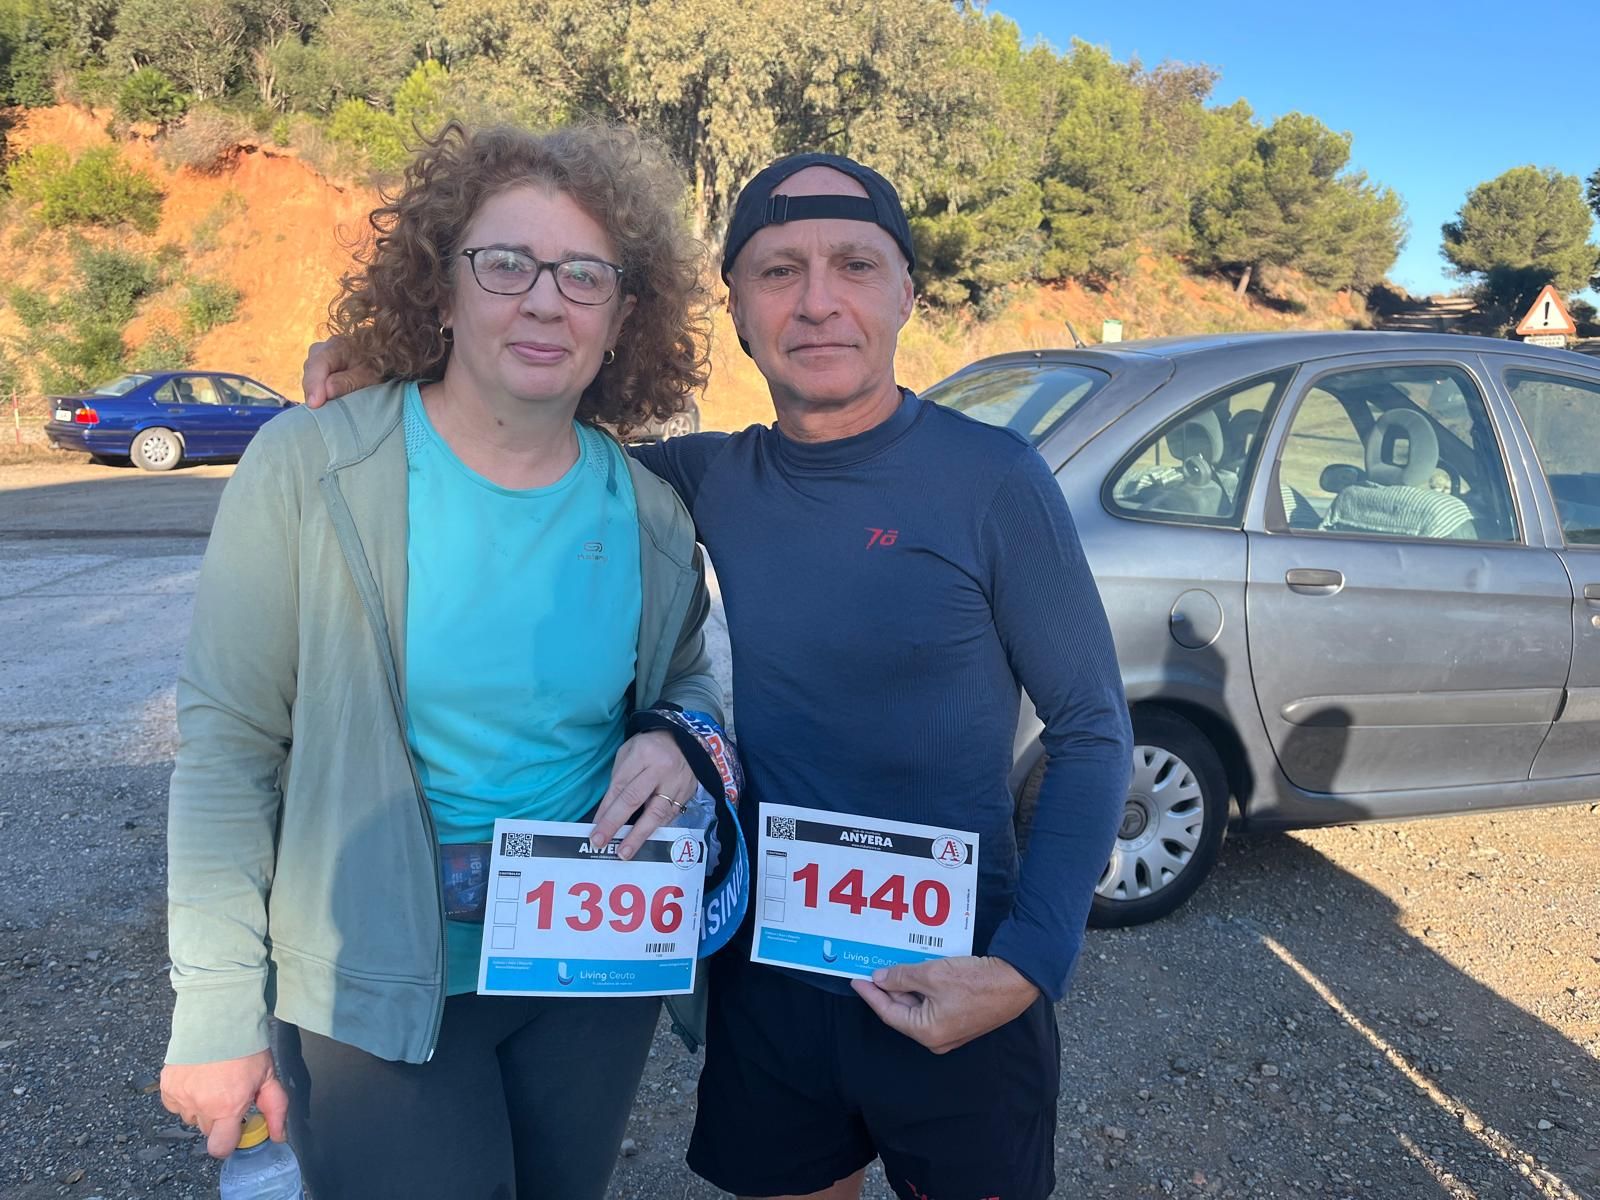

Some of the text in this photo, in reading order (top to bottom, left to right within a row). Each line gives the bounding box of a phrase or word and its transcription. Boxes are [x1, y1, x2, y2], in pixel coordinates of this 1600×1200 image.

[840, 830, 893, 848] ANYERA
[793, 863, 950, 926] 1440
[526, 880, 685, 933] 1396
[843, 951, 870, 965] Living
[580, 970, 607, 982] Living
